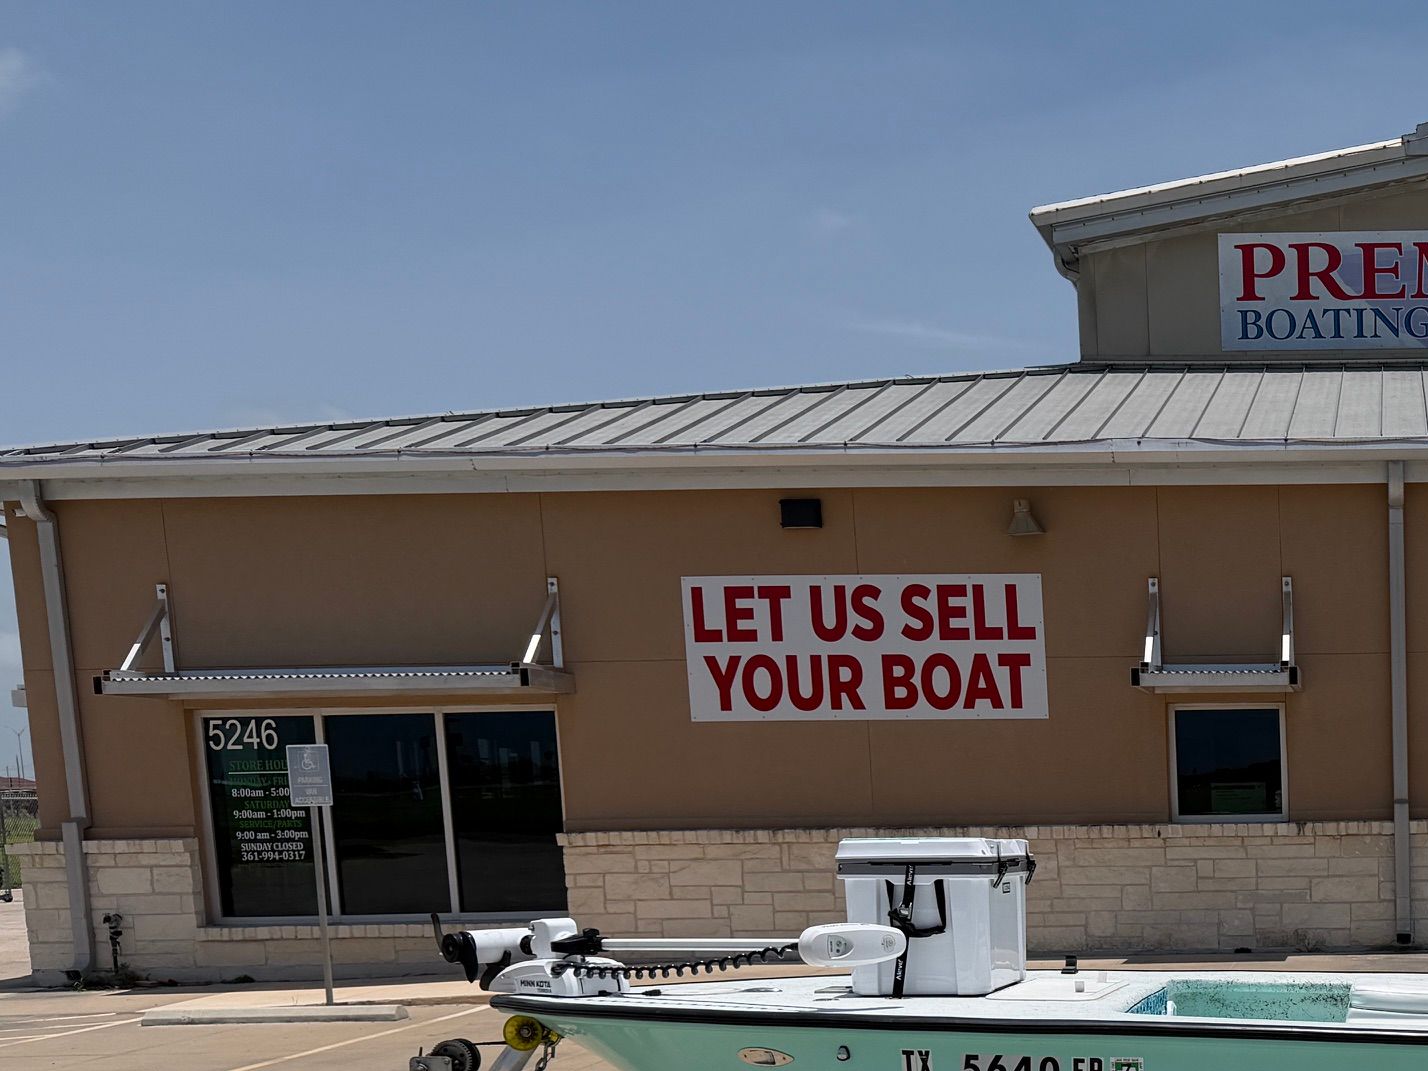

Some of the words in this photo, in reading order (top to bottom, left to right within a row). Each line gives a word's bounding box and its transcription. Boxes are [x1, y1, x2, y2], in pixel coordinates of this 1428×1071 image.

[690, 585, 792, 643] LET
[809, 584, 885, 642] US
[900, 583, 1037, 642] SELL
[703, 654, 867, 711] YOUR
[881, 652, 1032, 710] BOAT
[208, 719, 279, 750] 5246
[230, 760, 265, 770] STORE
[273, 776, 288, 786] FRI
[231, 788, 264, 797] 8:00am
[270, 787, 290, 797] 5:00
[244, 800, 289, 810] SATURDAY
[233, 810, 266, 819] 9:00am
[273, 808, 306, 819] 1:00pm
[236, 831, 255, 840] 9:00
[276, 830, 309, 841] 3:00pm
[241, 842, 272, 851] SUNDAY
[273, 842, 304, 850] CLOSED
[241, 851, 306, 861] 361-994-0317
